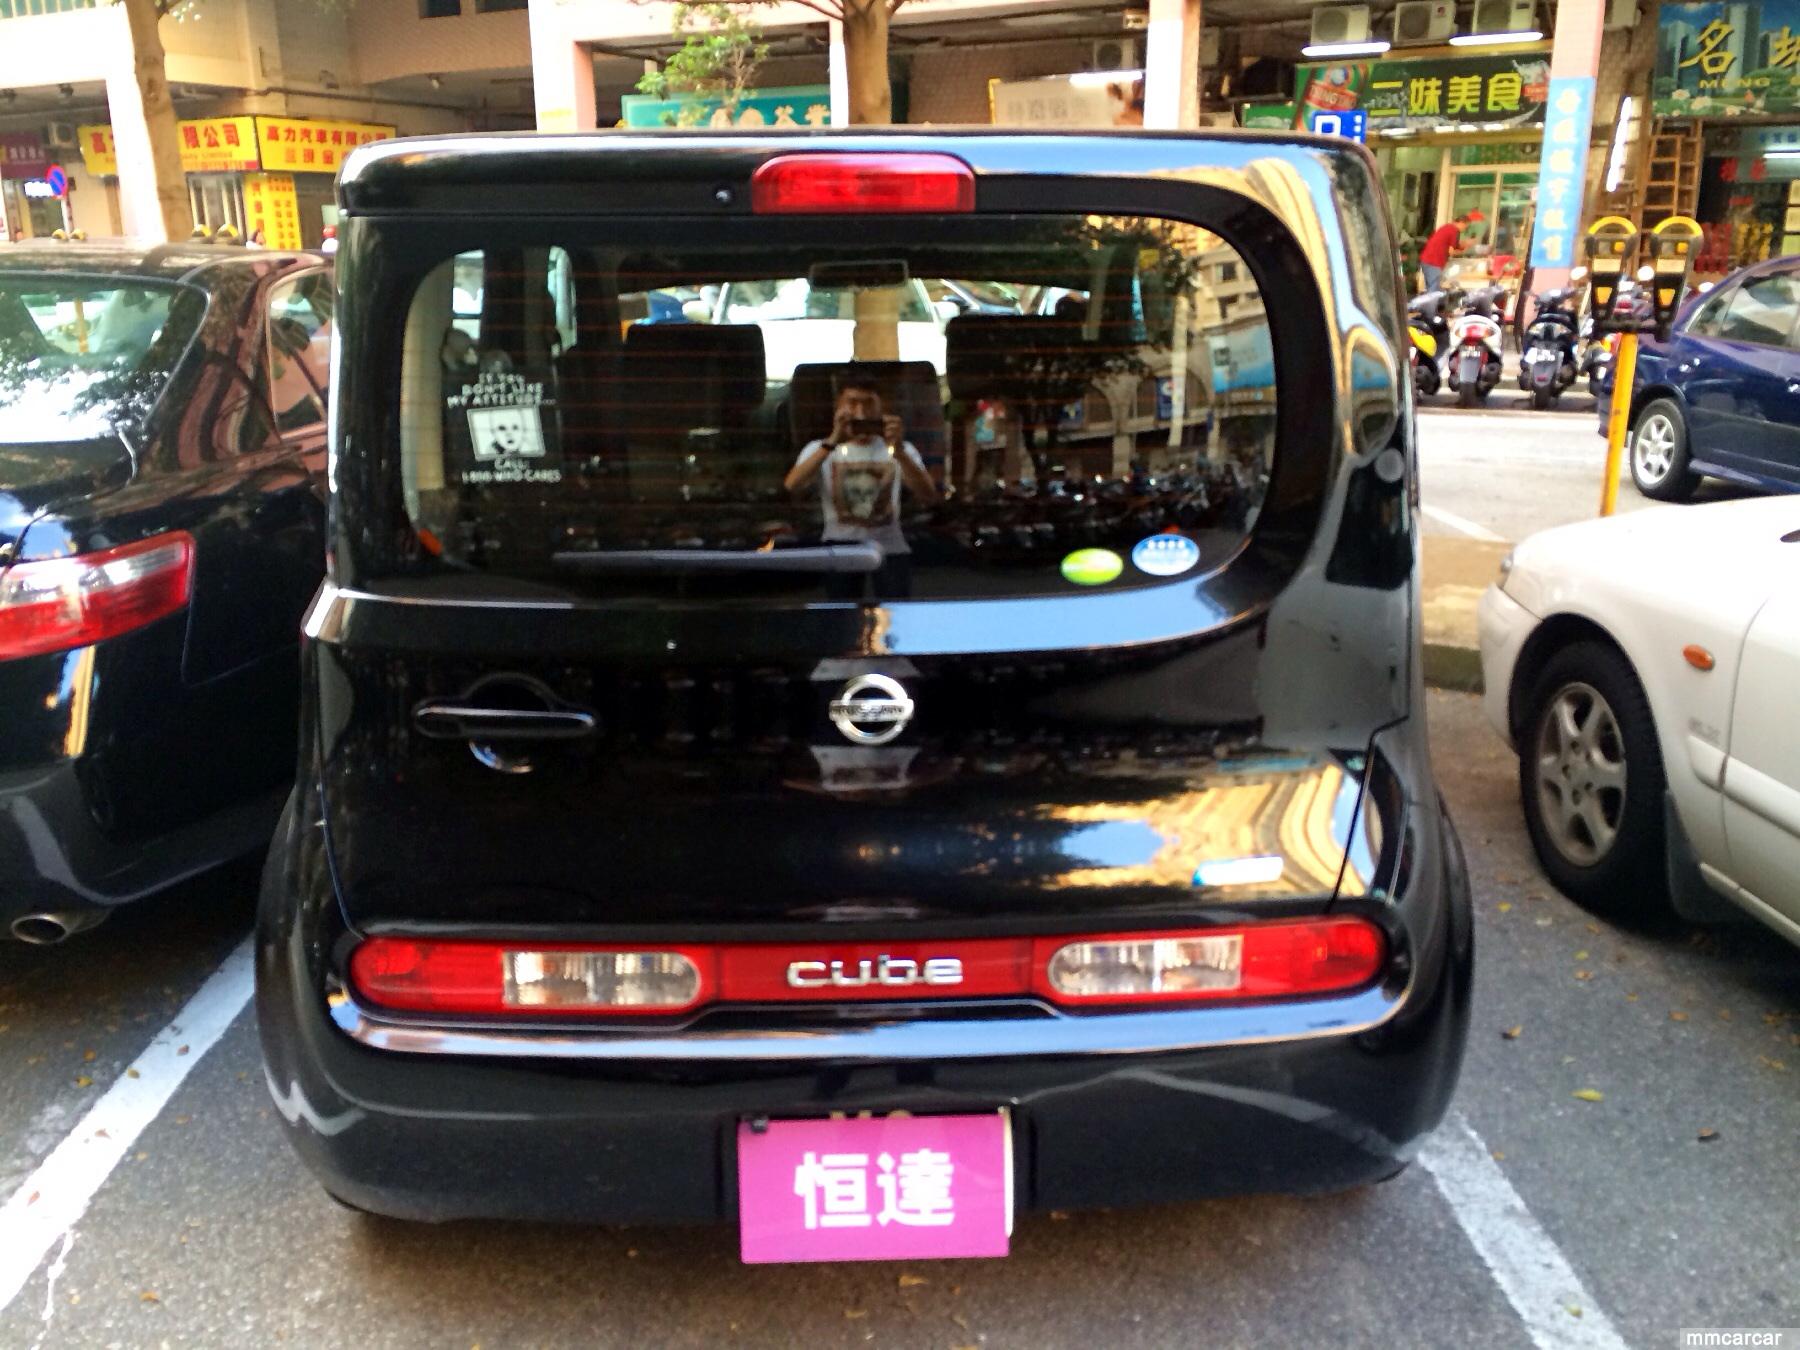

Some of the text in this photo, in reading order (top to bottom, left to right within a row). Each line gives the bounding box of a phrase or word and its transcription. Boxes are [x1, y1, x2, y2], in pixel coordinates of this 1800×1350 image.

[1370, 71, 1523, 117] 二妹美食
[787, 954, 964, 988] cube
[793, 1147, 956, 1230] 恒達
